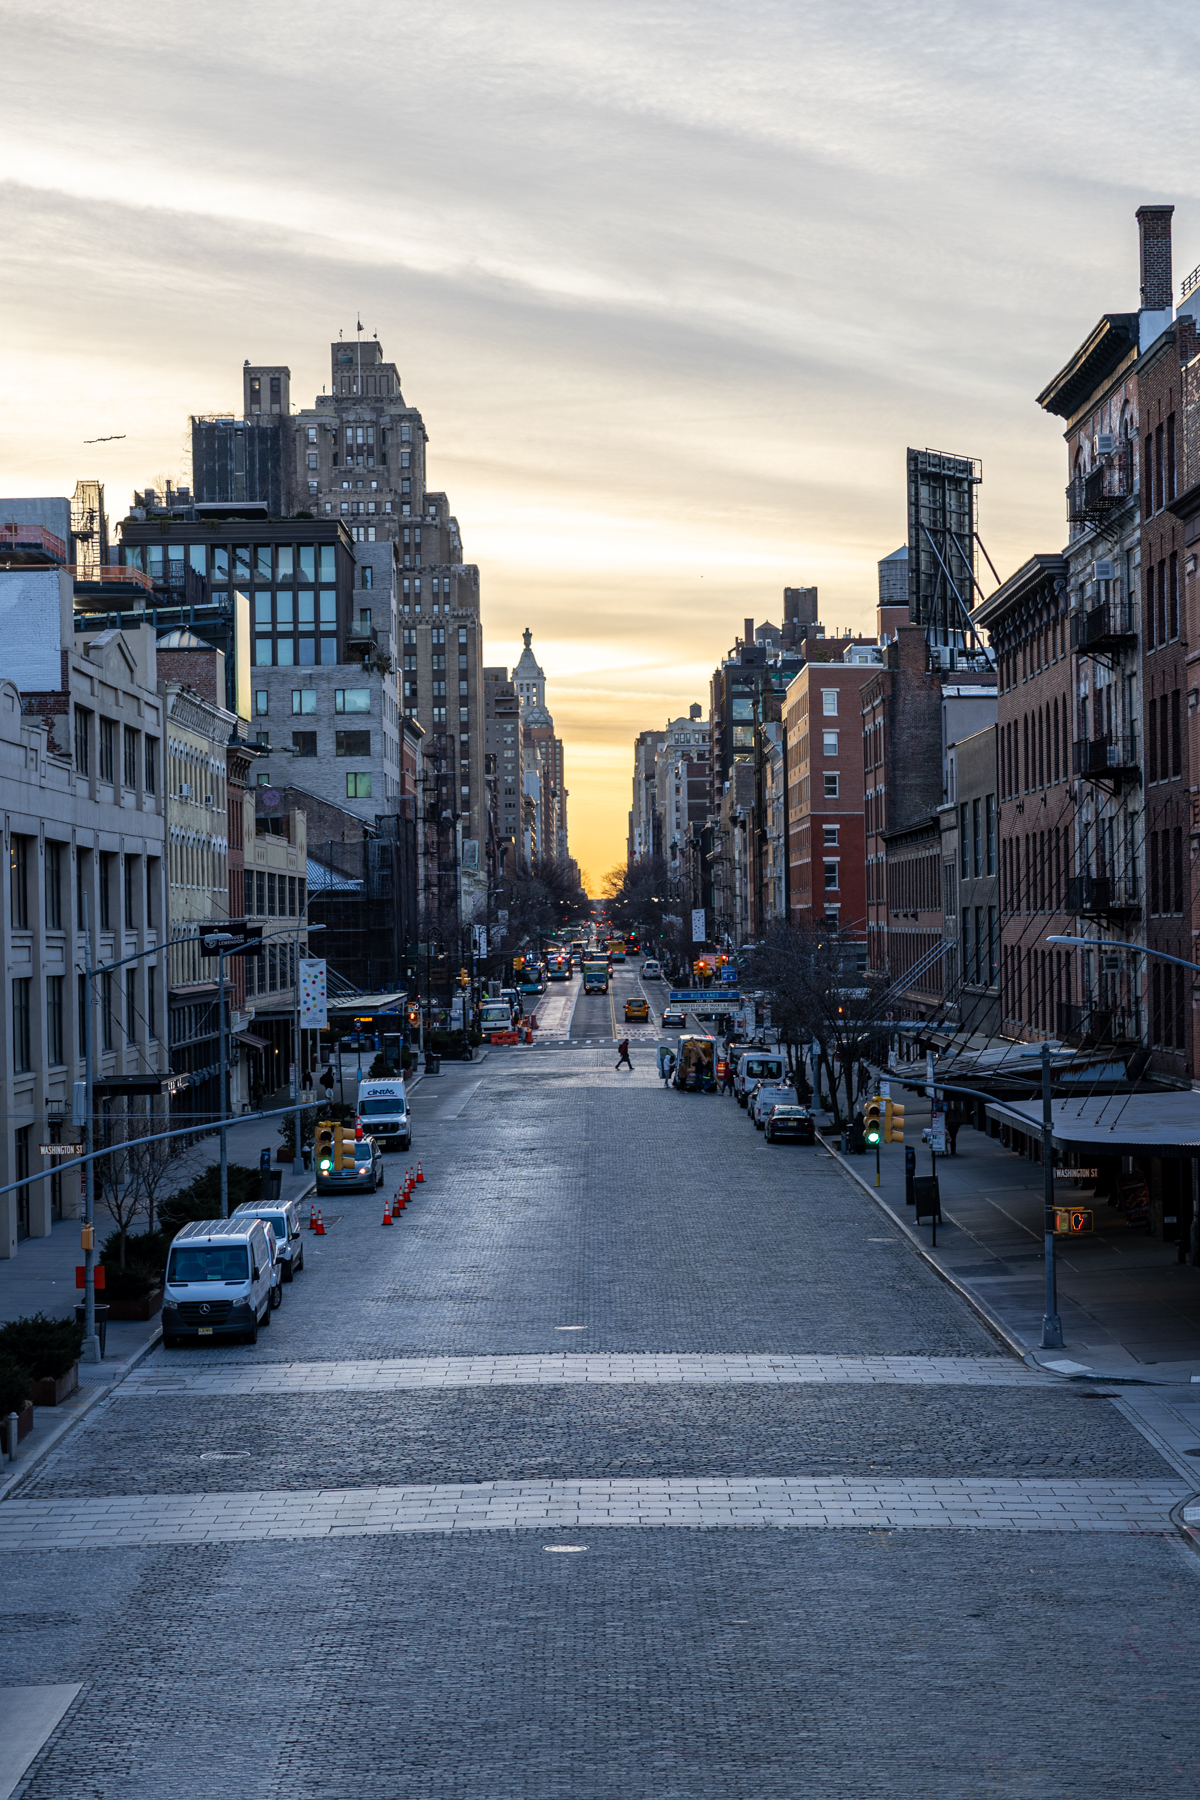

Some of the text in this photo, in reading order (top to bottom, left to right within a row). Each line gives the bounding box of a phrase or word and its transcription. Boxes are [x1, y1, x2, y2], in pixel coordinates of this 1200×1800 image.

[40, 1145, 83, 1155] WASHINGTON ST
[1056, 1168, 1098, 1178] WASHINGTON ST
